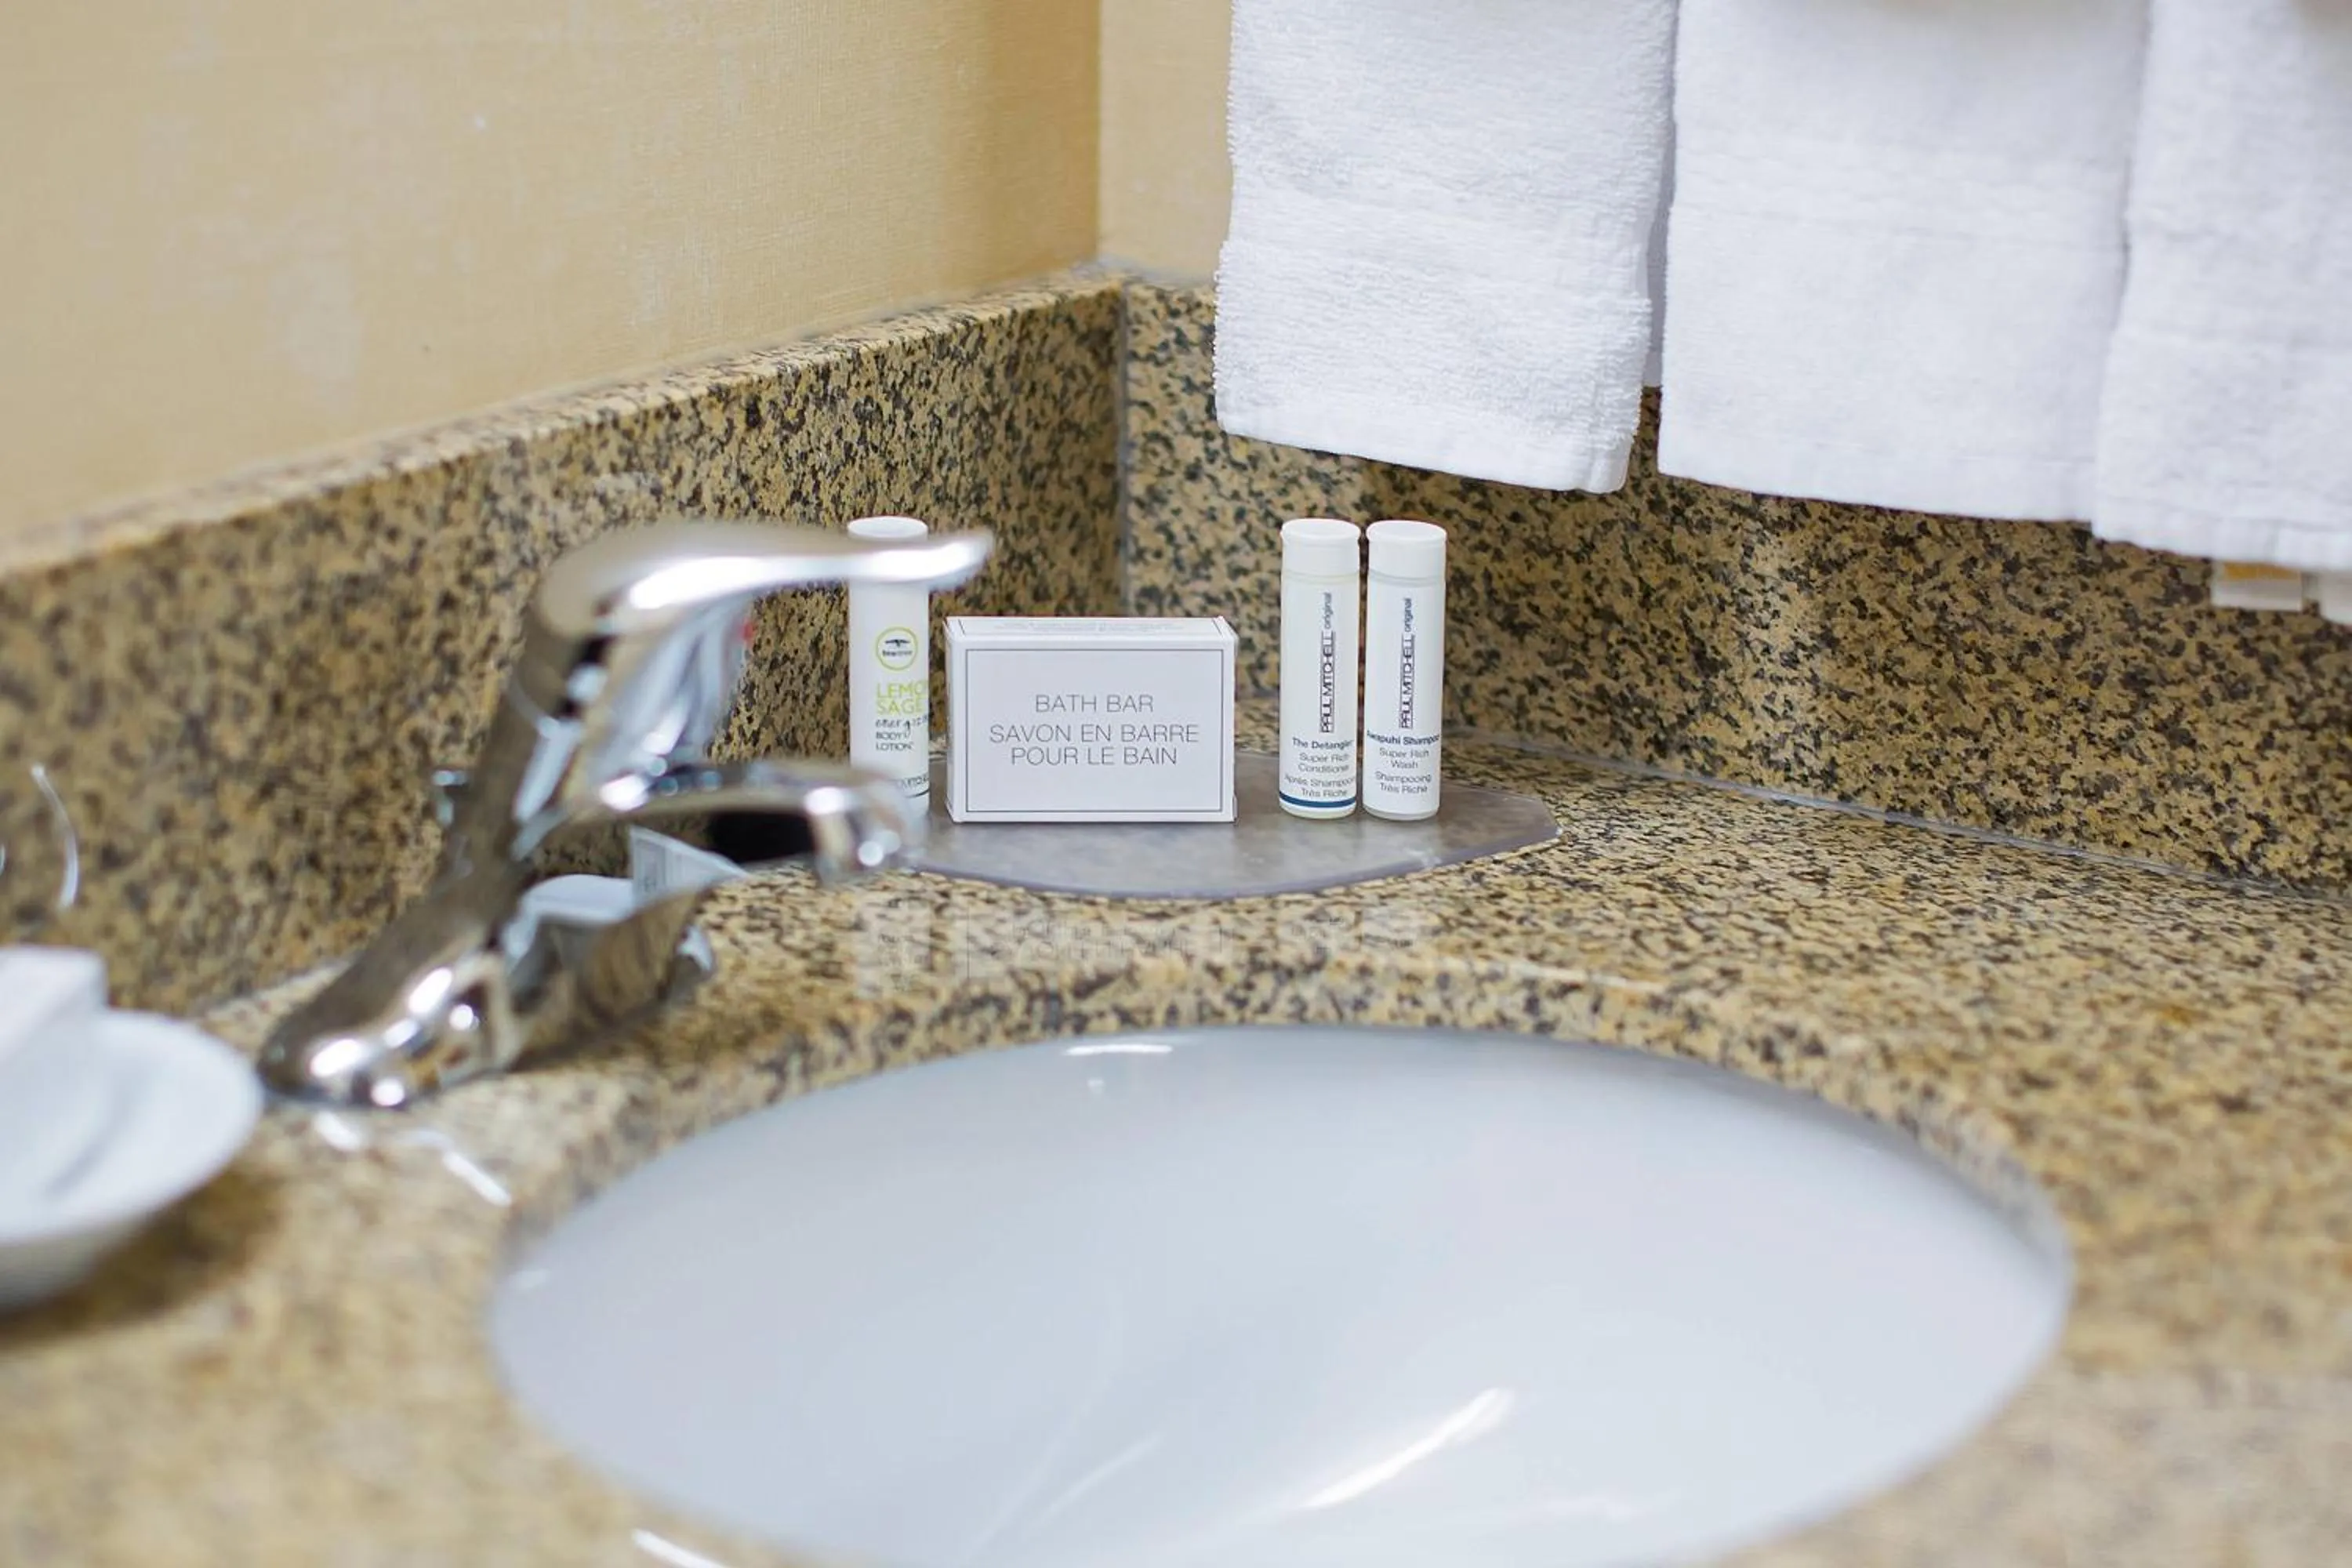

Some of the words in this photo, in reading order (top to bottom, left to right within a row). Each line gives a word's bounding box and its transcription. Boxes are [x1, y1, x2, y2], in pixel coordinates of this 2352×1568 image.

[877, 681, 928, 699] LEMO
[877, 697, 924, 714] SAGE
[1035, 695, 1097, 712] BATH
[1106, 695, 1154, 712] BAR
[989, 724, 1071, 743] SAVON
[1081, 724, 1111, 742] EN
[1121, 724, 1200, 742] BARRE
[1292, 737, 1308, 748] The
[1011, 747, 1079, 765] POUR
[1087, 747, 1115, 765] LE
[1124, 747, 1178, 765] BAIN
[1299, 753, 1328, 762] Super
[1380, 747, 1406, 757] Super
[1391, 760, 1418, 768] Wash
